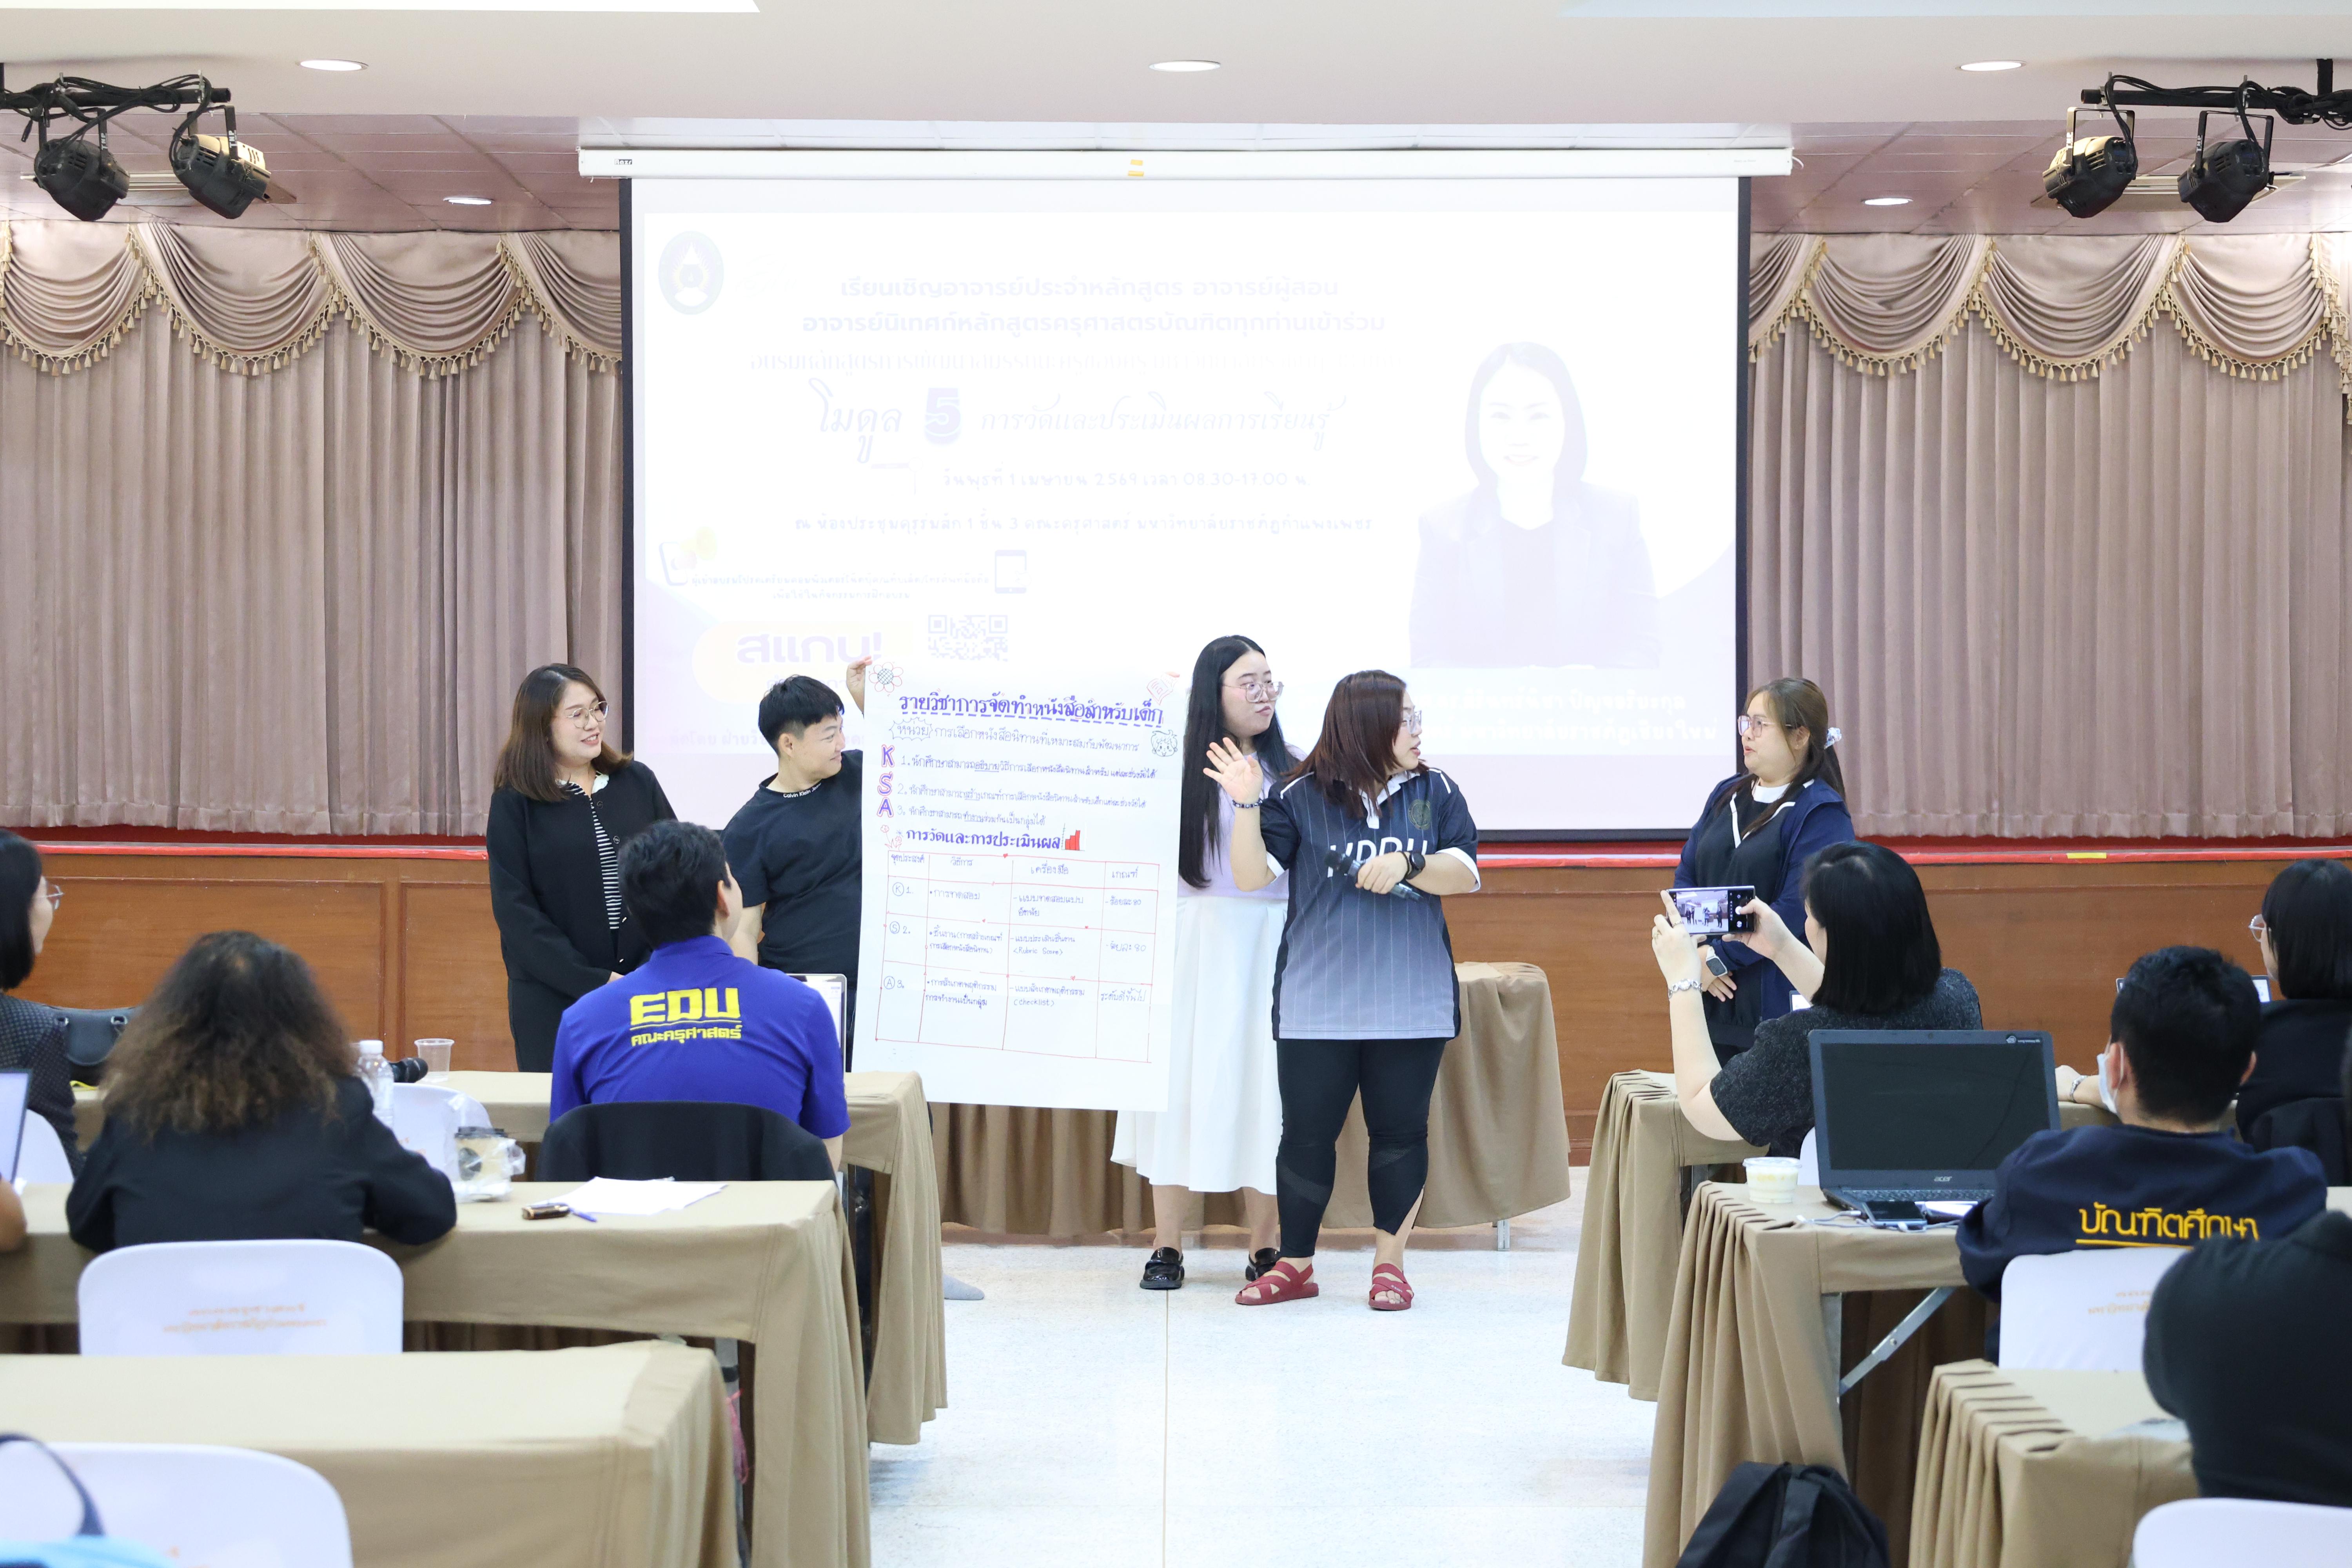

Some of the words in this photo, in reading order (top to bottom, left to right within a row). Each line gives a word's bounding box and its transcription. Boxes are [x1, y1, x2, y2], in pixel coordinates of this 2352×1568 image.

[808, 378, 902, 464] โมดูล
[924, 386, 963, 445] 5
[899, 691, 1163, 724] รายวิชาการจัดทำหนังสือสำหรับเด็ก
[897, 720, 930, 737] หน่วย
[881, 744, 895, 768] K
[877, 771, 893, 796] S
[877, 797, 894, 818] A
[906, 828, 1061, 849] การวัดและการประเมินผล
[951, 856, 973, 866] วิธีการ
[1112, 866, 1139, 878] เกณฑ์
[630, 987, 741, 1025] EDU
[631, 1024, 743, 1046] คณะครุศาสตร์
